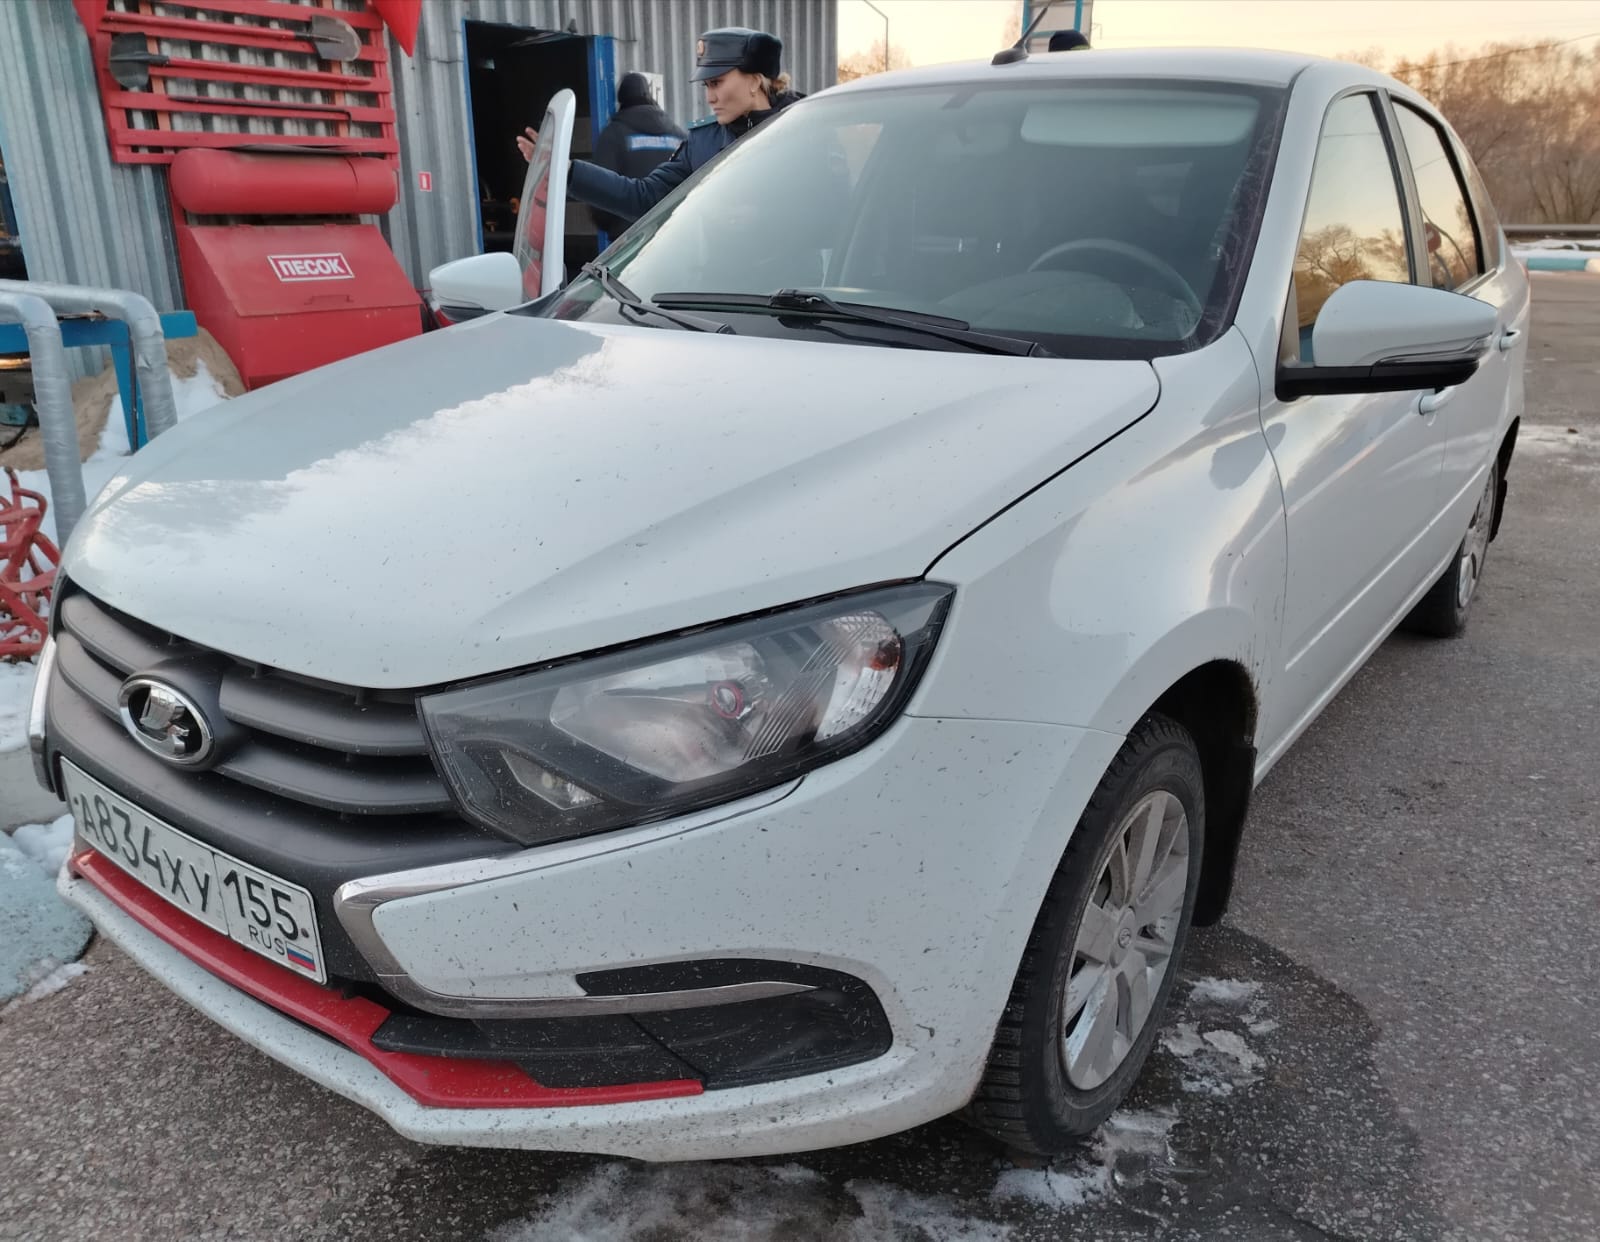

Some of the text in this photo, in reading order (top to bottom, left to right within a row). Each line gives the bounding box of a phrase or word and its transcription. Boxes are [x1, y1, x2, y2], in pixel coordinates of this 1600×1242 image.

[278, 258, 346, 276] ПЕСОК
[79, 793, 299, 940] А834ХУ 155
[248, 924, 287, 956] RUS
